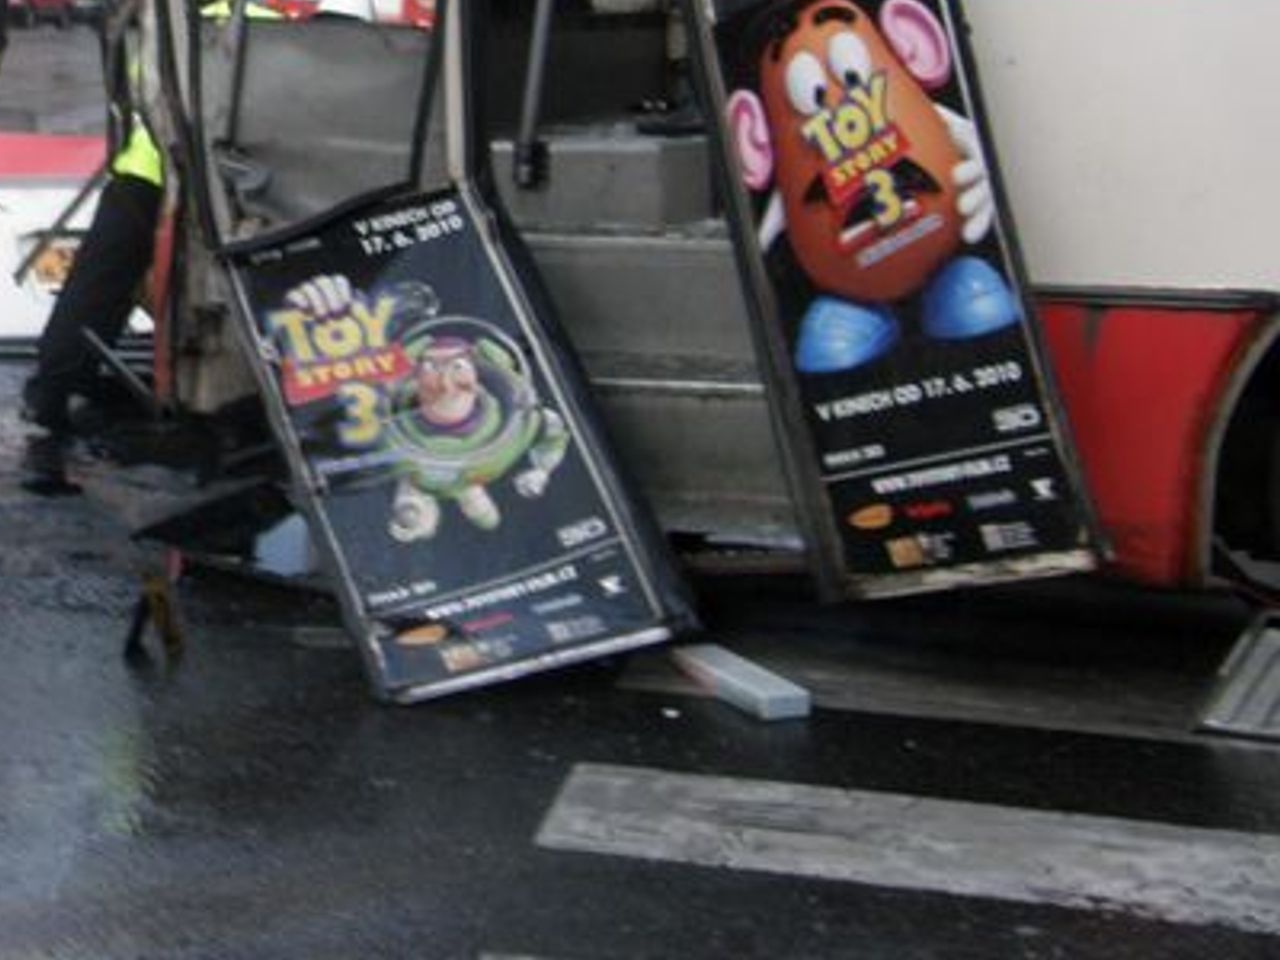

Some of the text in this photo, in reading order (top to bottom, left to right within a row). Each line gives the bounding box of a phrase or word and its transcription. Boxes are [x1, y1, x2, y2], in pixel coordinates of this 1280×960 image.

[801, 72, 889, 166] TOY
[830, 132, 900, 187] STORY
[865, 168, 902, 227] 3
[415, 213, 464, 242] 2010
[270, 292, 402, 363] TOY
[293, 351, 397, 388] STORY
[972, 360, 1022, 390] 2010
[337, 381, 381, 444] 3
